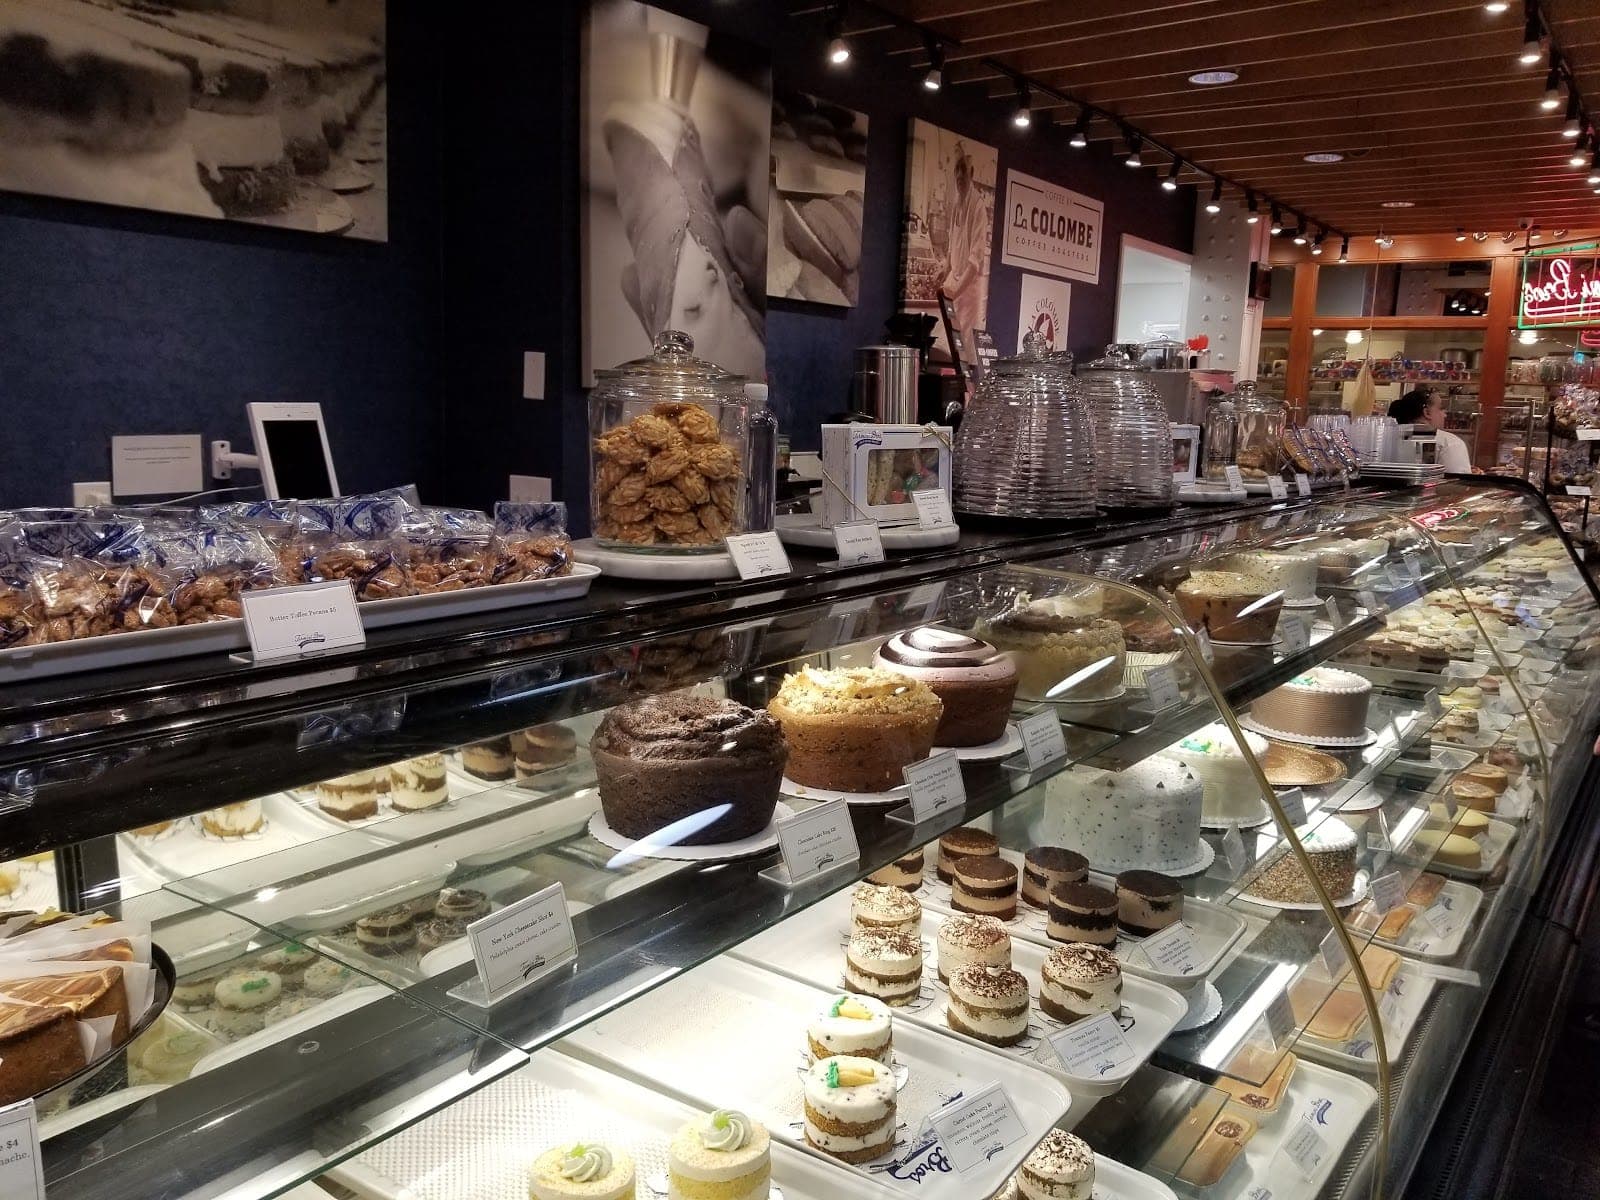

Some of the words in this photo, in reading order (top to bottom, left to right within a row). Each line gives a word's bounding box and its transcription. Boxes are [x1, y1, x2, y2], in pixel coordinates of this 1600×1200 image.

[1013, 203, 1027, 230] La
[1031, 207, 1093, 248] COLOMBE
[1015, 235, 1047, 251] COFFEE
[1051, 247, 1089, 262] ROASTERS
[502, 931, 514, 941] York
[6, 1138, 18, 1149] $4
[909, 1146, 953, 1185] Bros
